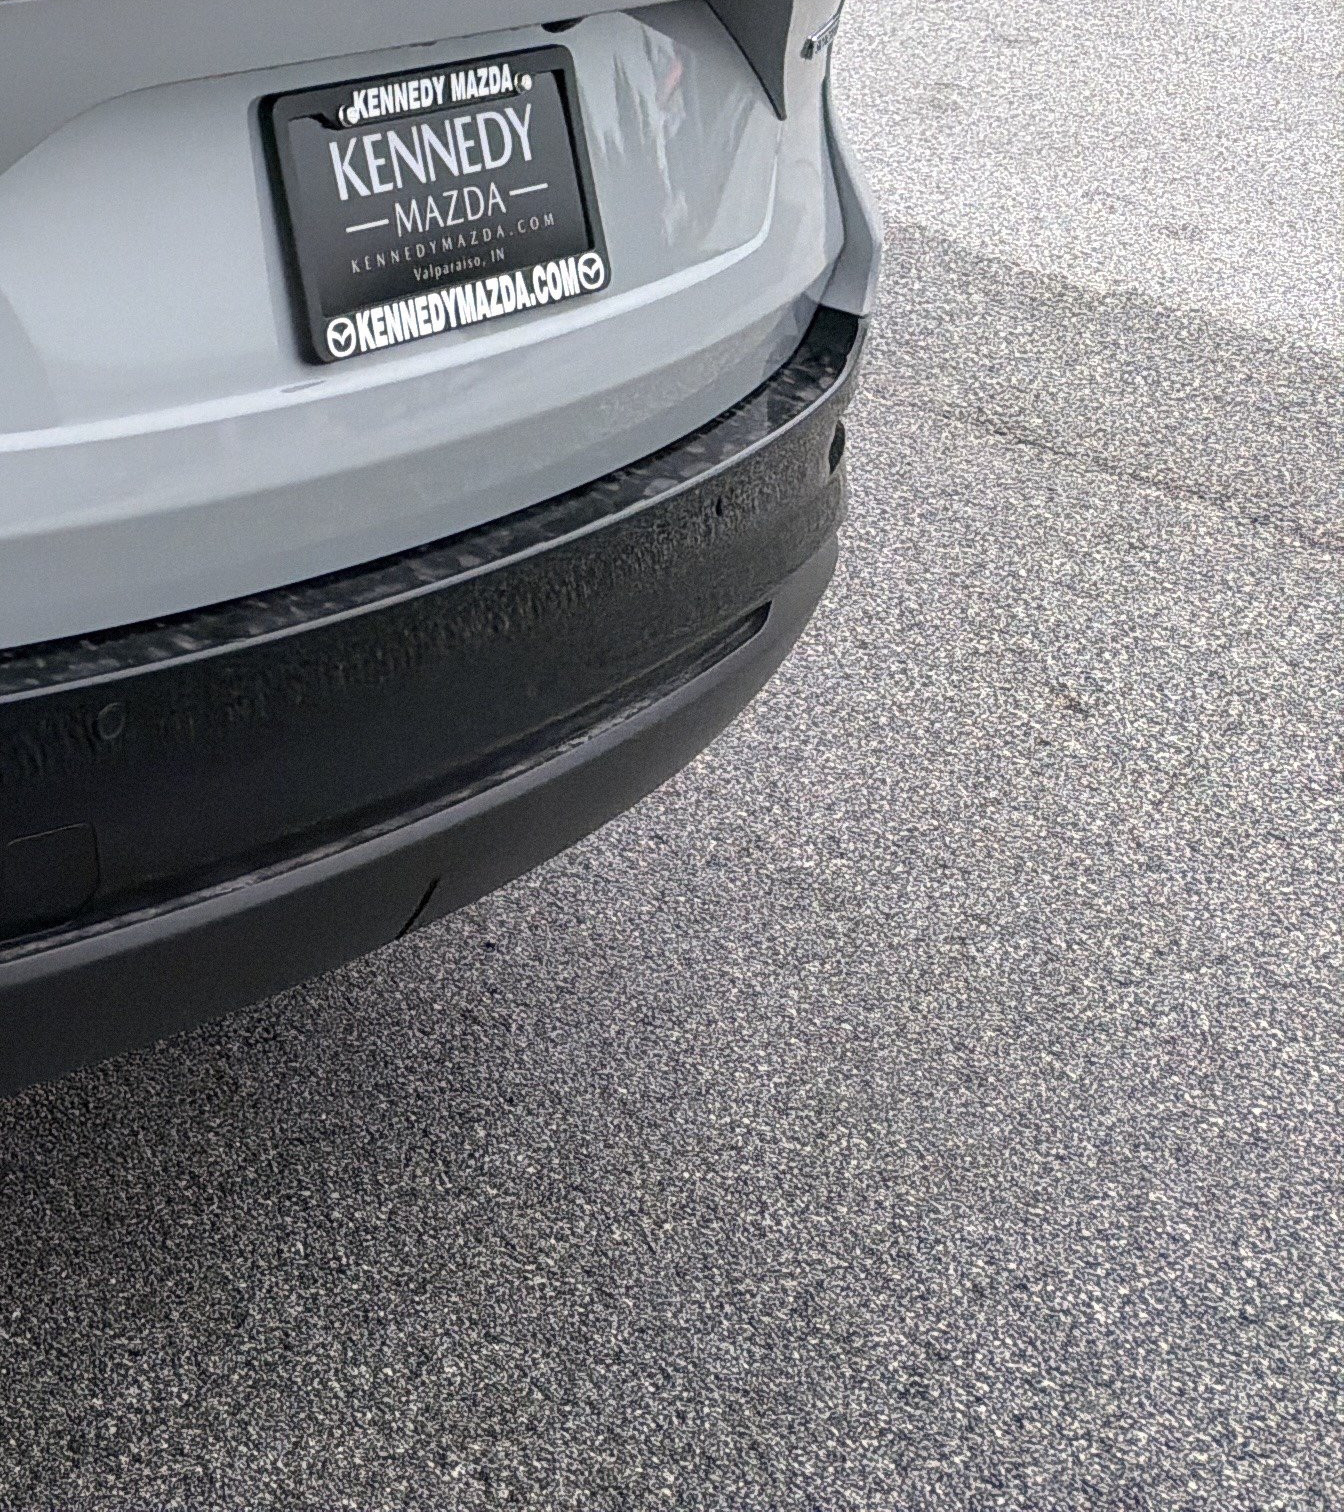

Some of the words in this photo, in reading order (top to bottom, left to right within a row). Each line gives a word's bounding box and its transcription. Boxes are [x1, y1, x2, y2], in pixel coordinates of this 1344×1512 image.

[352, 75, 446, 119] KENNEDY
[451, 63, 514, 102] MAZDA
[328, 102, 533, 201] KENNEDY
[394, 181, 507, 238] MAZDA
[350, 212, 556, 275] KENNEDYMAZDA.COM
[490, 246, 506, 263] IN
[355, 256, 581, 353] KENNEDYMAZDA.COM
